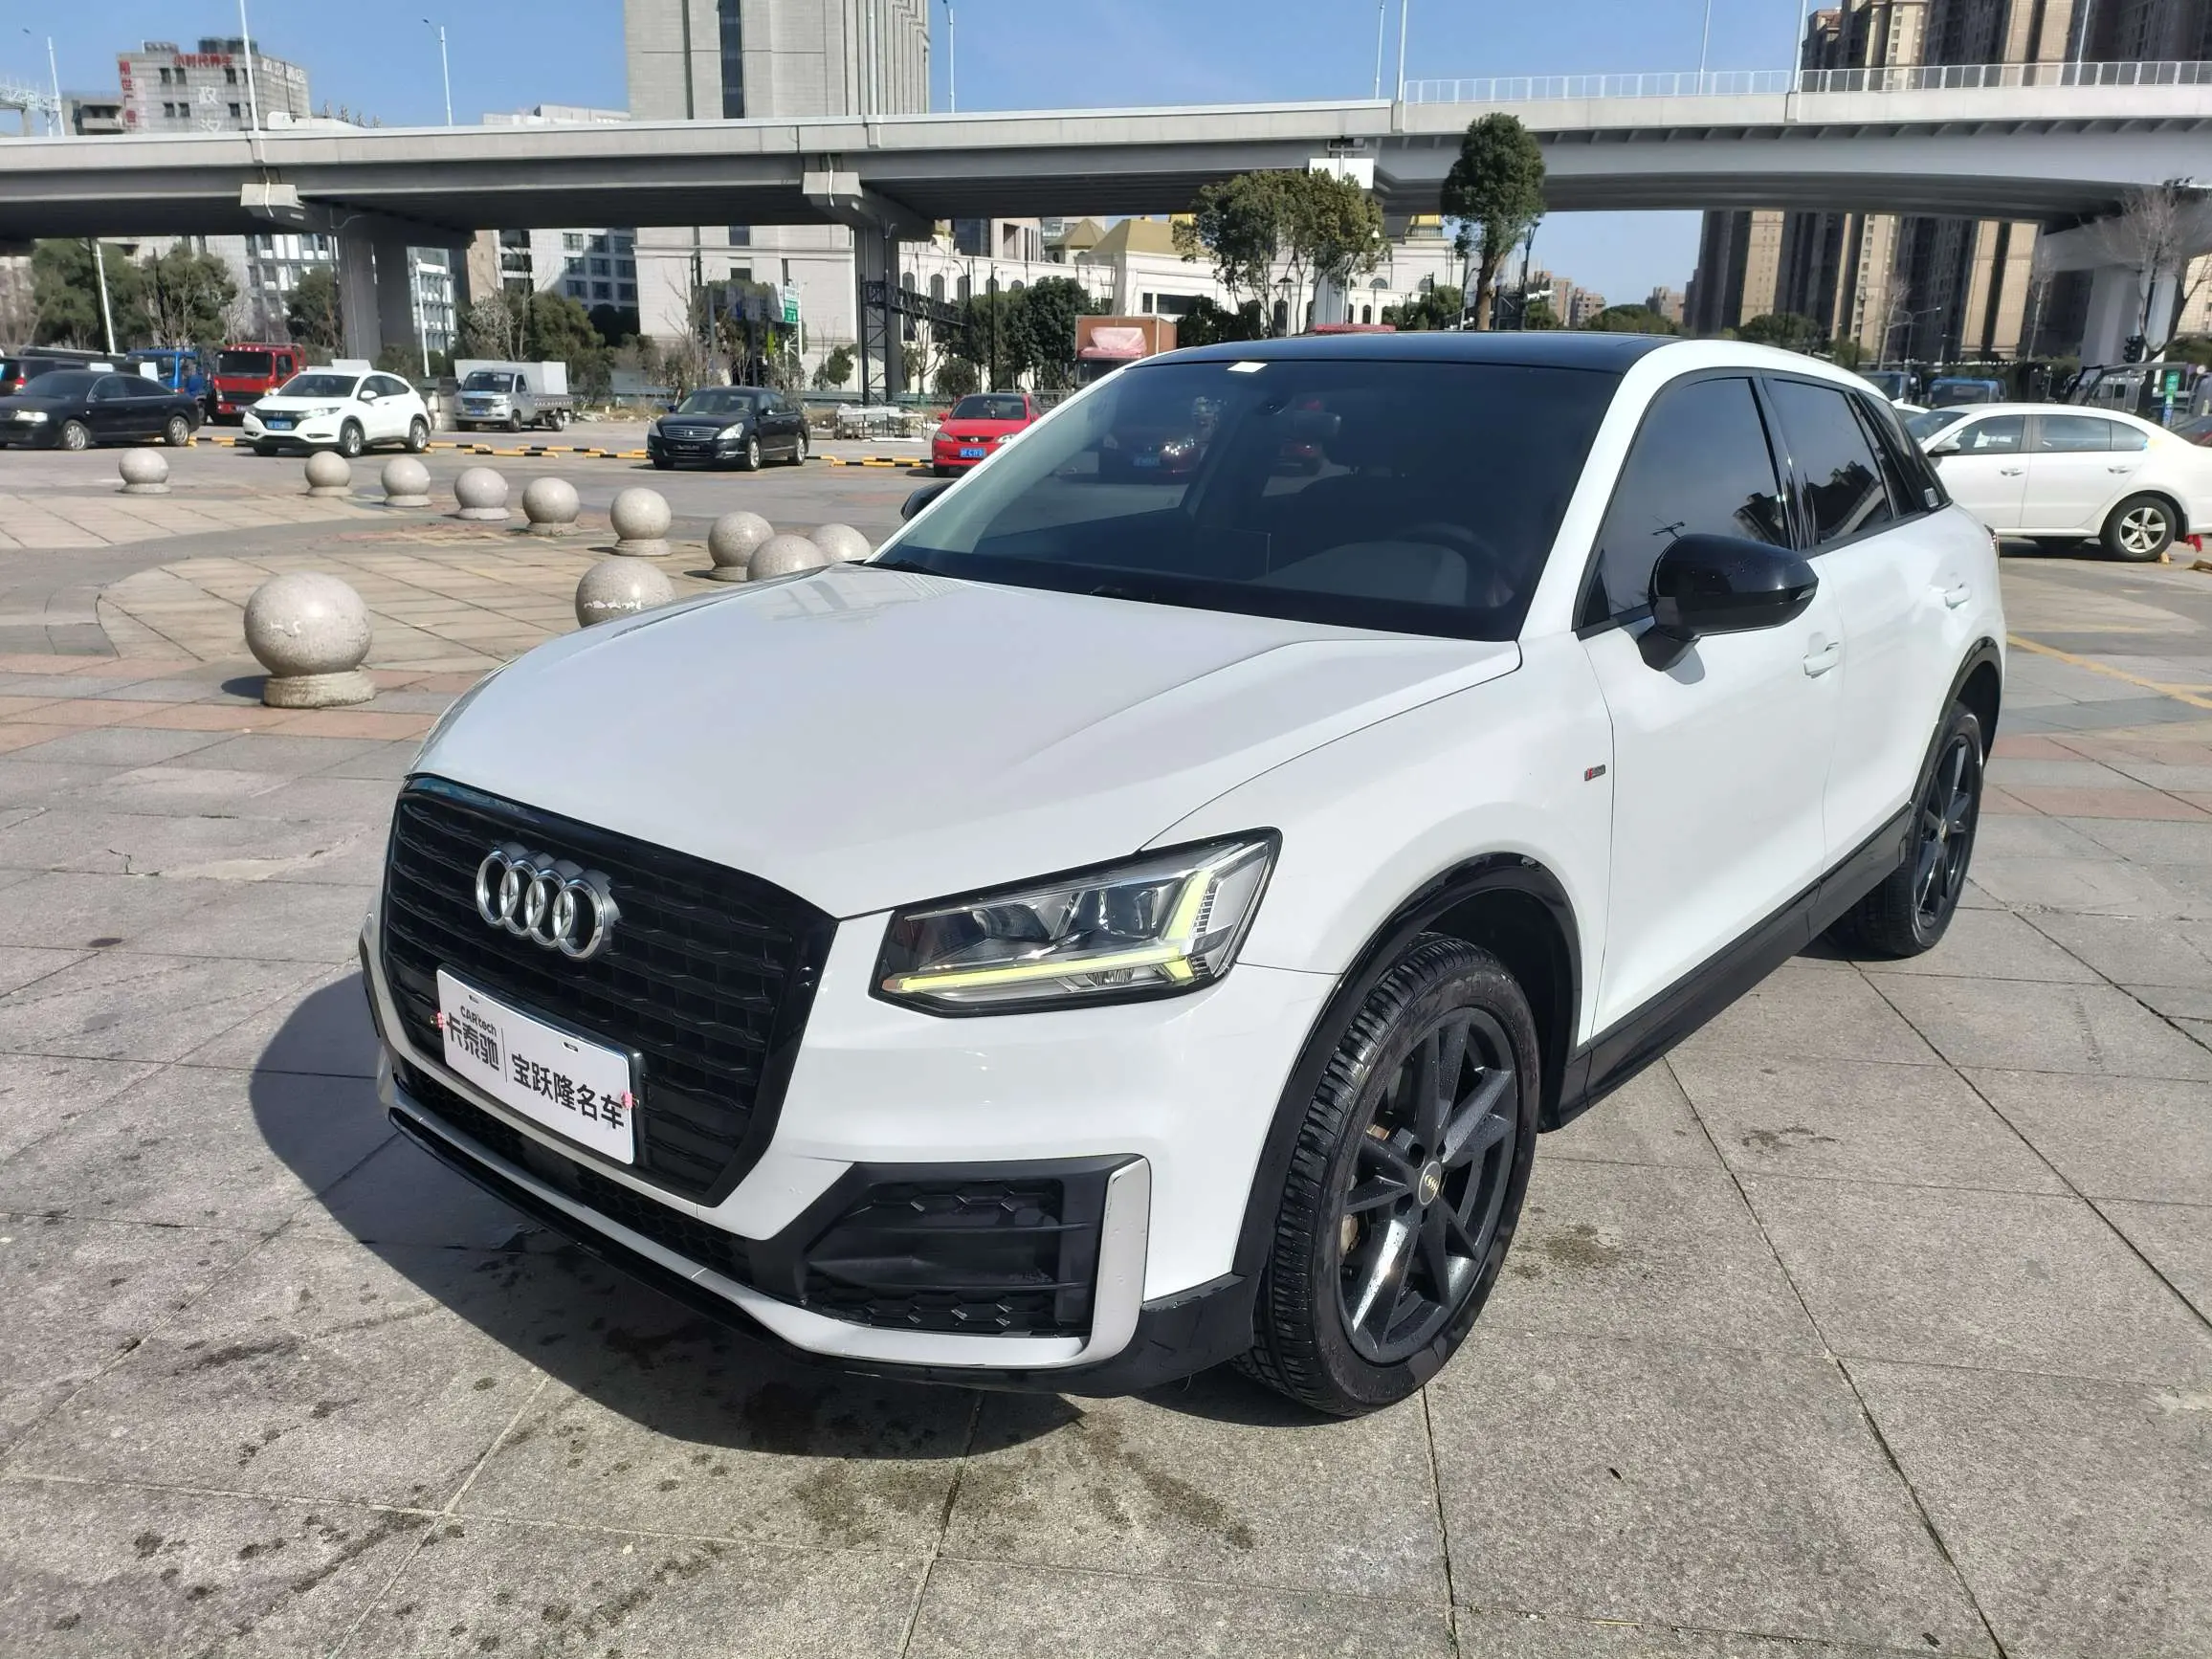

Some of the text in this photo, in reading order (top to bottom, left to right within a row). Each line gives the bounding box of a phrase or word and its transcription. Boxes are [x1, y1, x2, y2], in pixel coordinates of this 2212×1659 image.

[460, 1006, 498, 1037] CARtech
[511, 1052, 625, 1129] 宝跃隆名车
